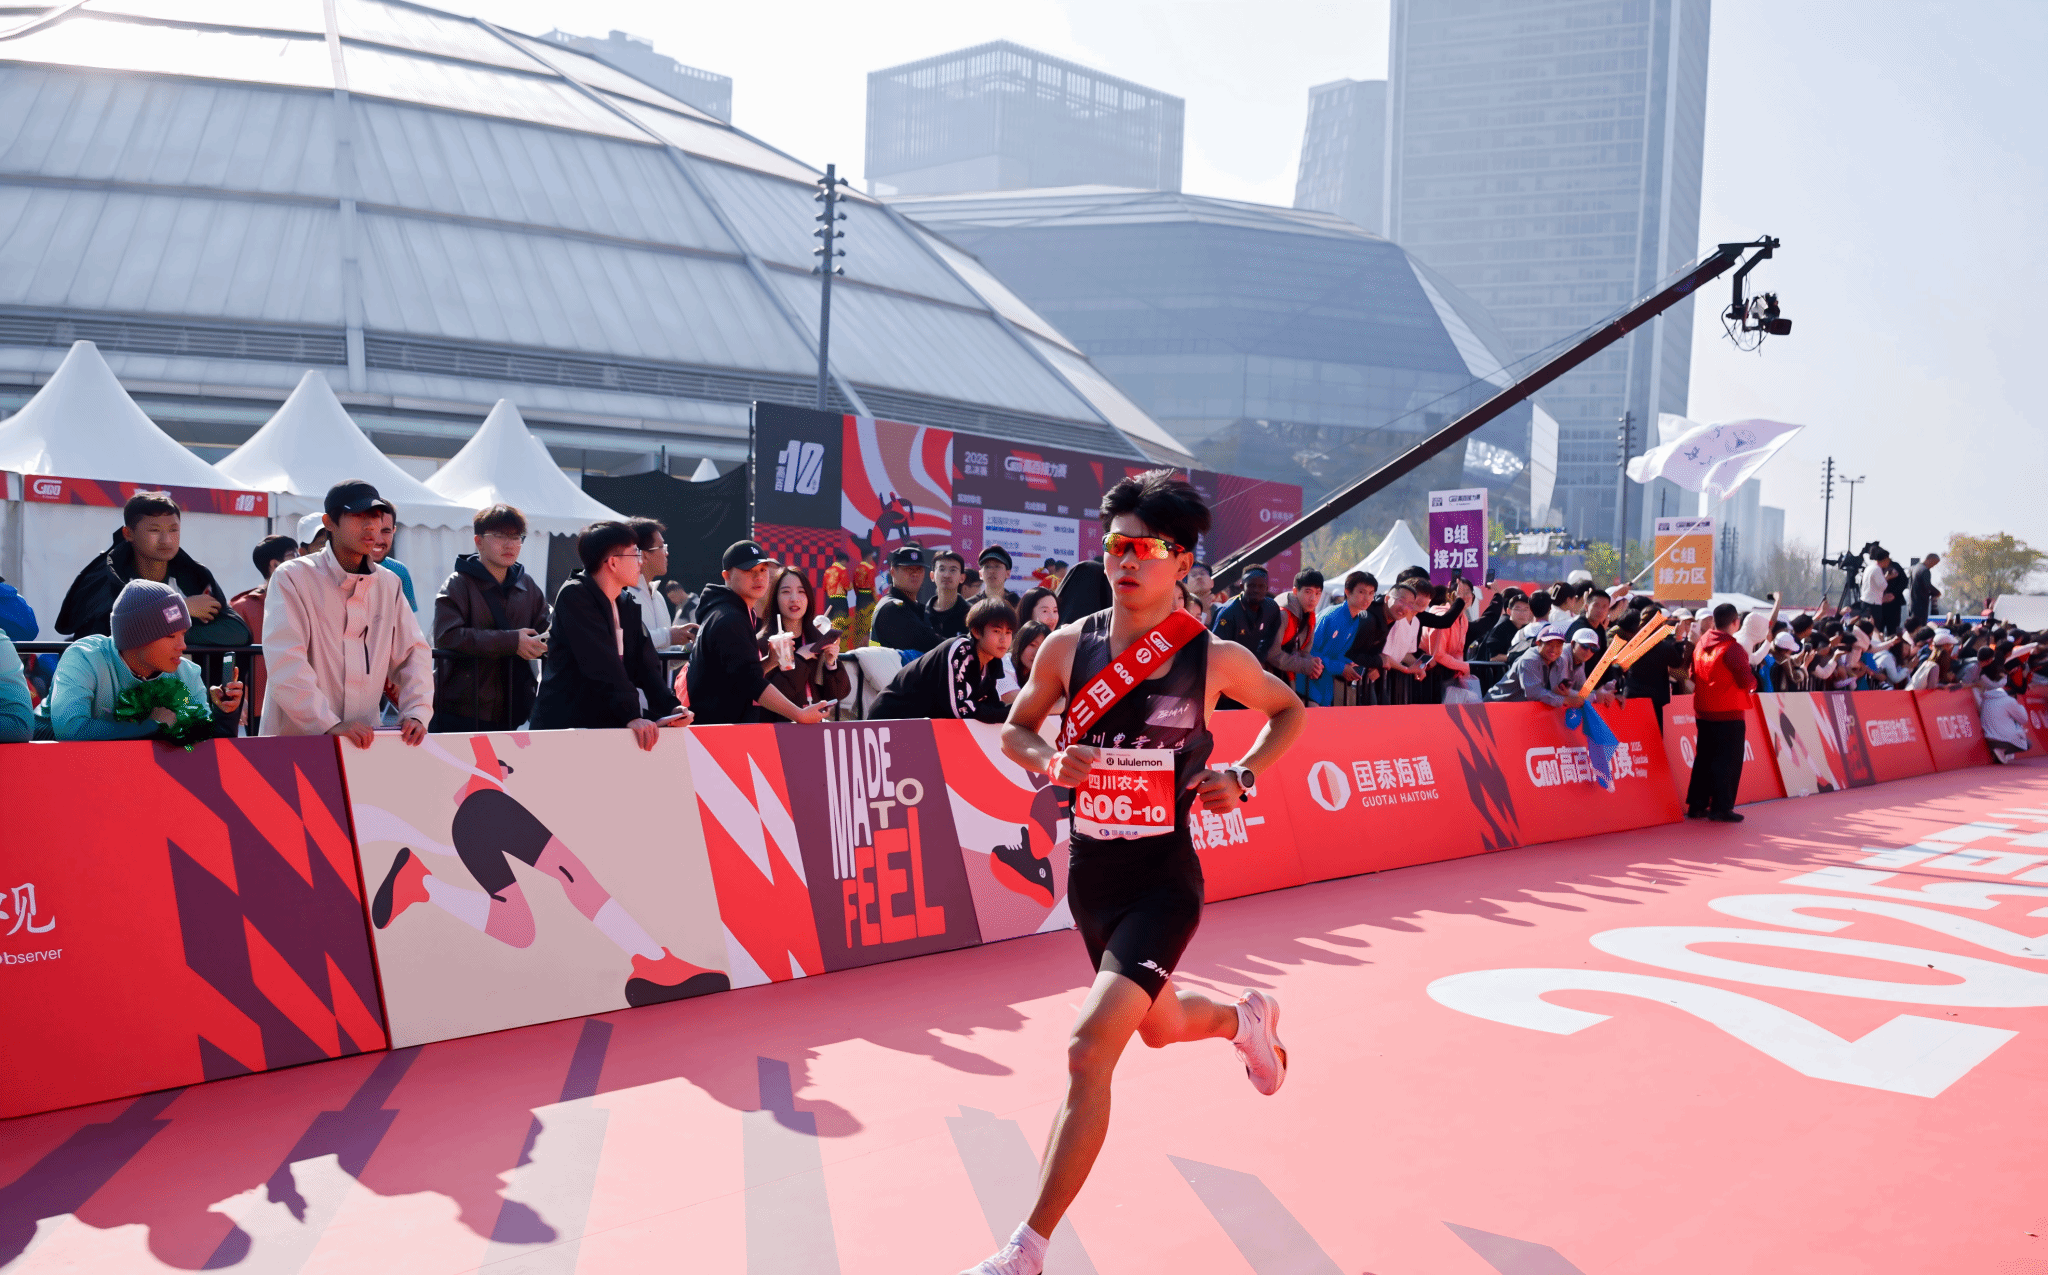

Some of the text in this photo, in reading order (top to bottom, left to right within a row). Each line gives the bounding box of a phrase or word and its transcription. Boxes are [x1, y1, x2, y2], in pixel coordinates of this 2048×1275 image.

[964, 451, 989, 465] 2025
[1444, 524, 1469, 544] B组
[1434, 548, 1478, 569] 接力区
[1670, 547, 1697, 564] C组
[1658, 567, 1707, 585] 接力区
[1113, 662, 1135, 686] G06
[1117, 757, 1163, 767] lululemon
[1088, 773, 1149, 792] 四川农大
[1352, 755, 1435, 793] 国泰海通
[823, 726, 896, 880] MADE
[1079, 791, 1166, 822] G06-10
[1362, 788, 1439, 808] GUOTAI HAITONG
[842, 806, 946, 949] FEEL
